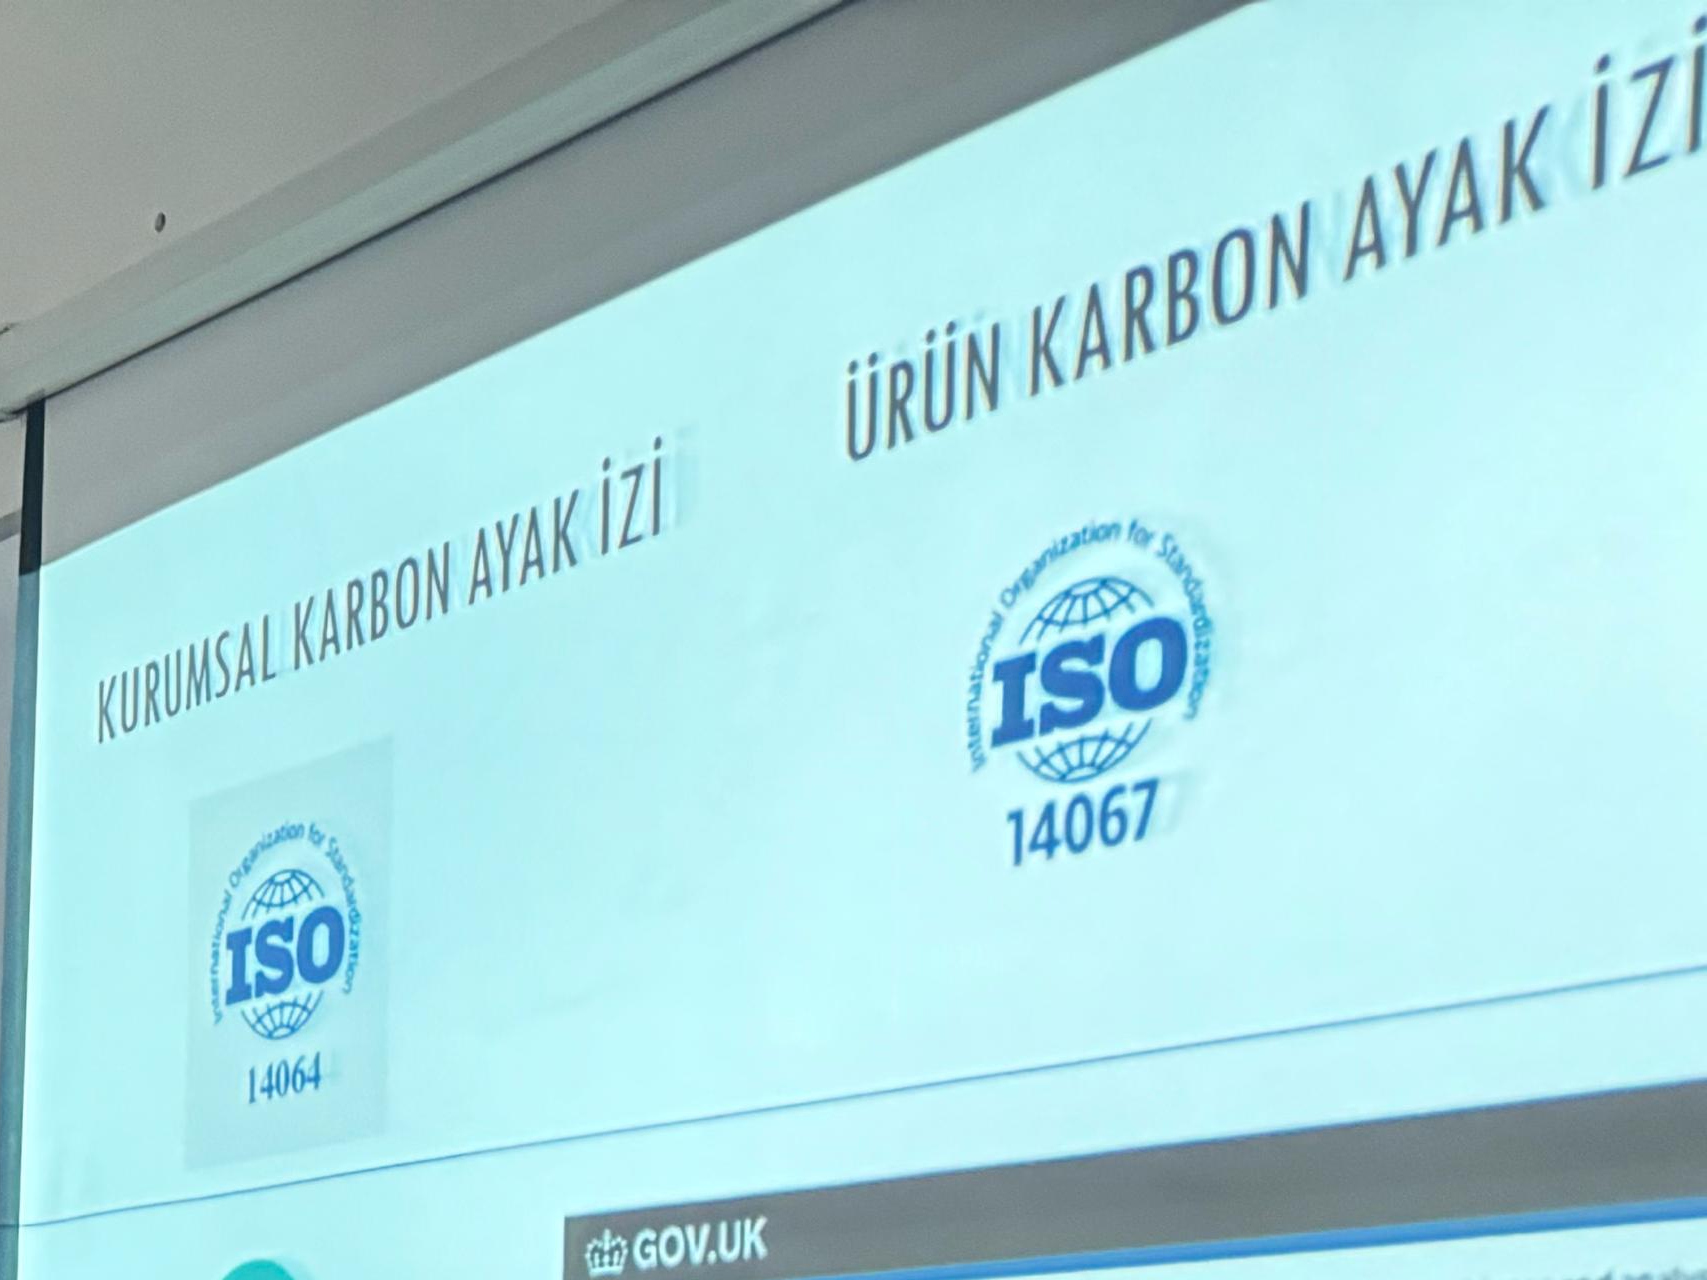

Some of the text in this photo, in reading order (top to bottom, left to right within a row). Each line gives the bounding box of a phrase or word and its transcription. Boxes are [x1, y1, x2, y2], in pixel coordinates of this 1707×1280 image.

[844, 16, 1707, 462] ÜRÜN KARBON AYAK İZİ
[97, 436, 664, 743] KURUMSAL KARBON AYAK İZİ
[1000, 520, 1121, 608] Organization
[1127, 518, 1153, 548] for
[991, 617, 1187, 748] ISO
[229, 823, 304, 887] Organization
[308, 822, 325, 846] for
[1007, 778, 1159, 867] 14067
[225, 905, 345, 1006] ISO
[248, 1052, 321, 1104] 14064
[633, 1216, 768, 1269] GOV.UK
